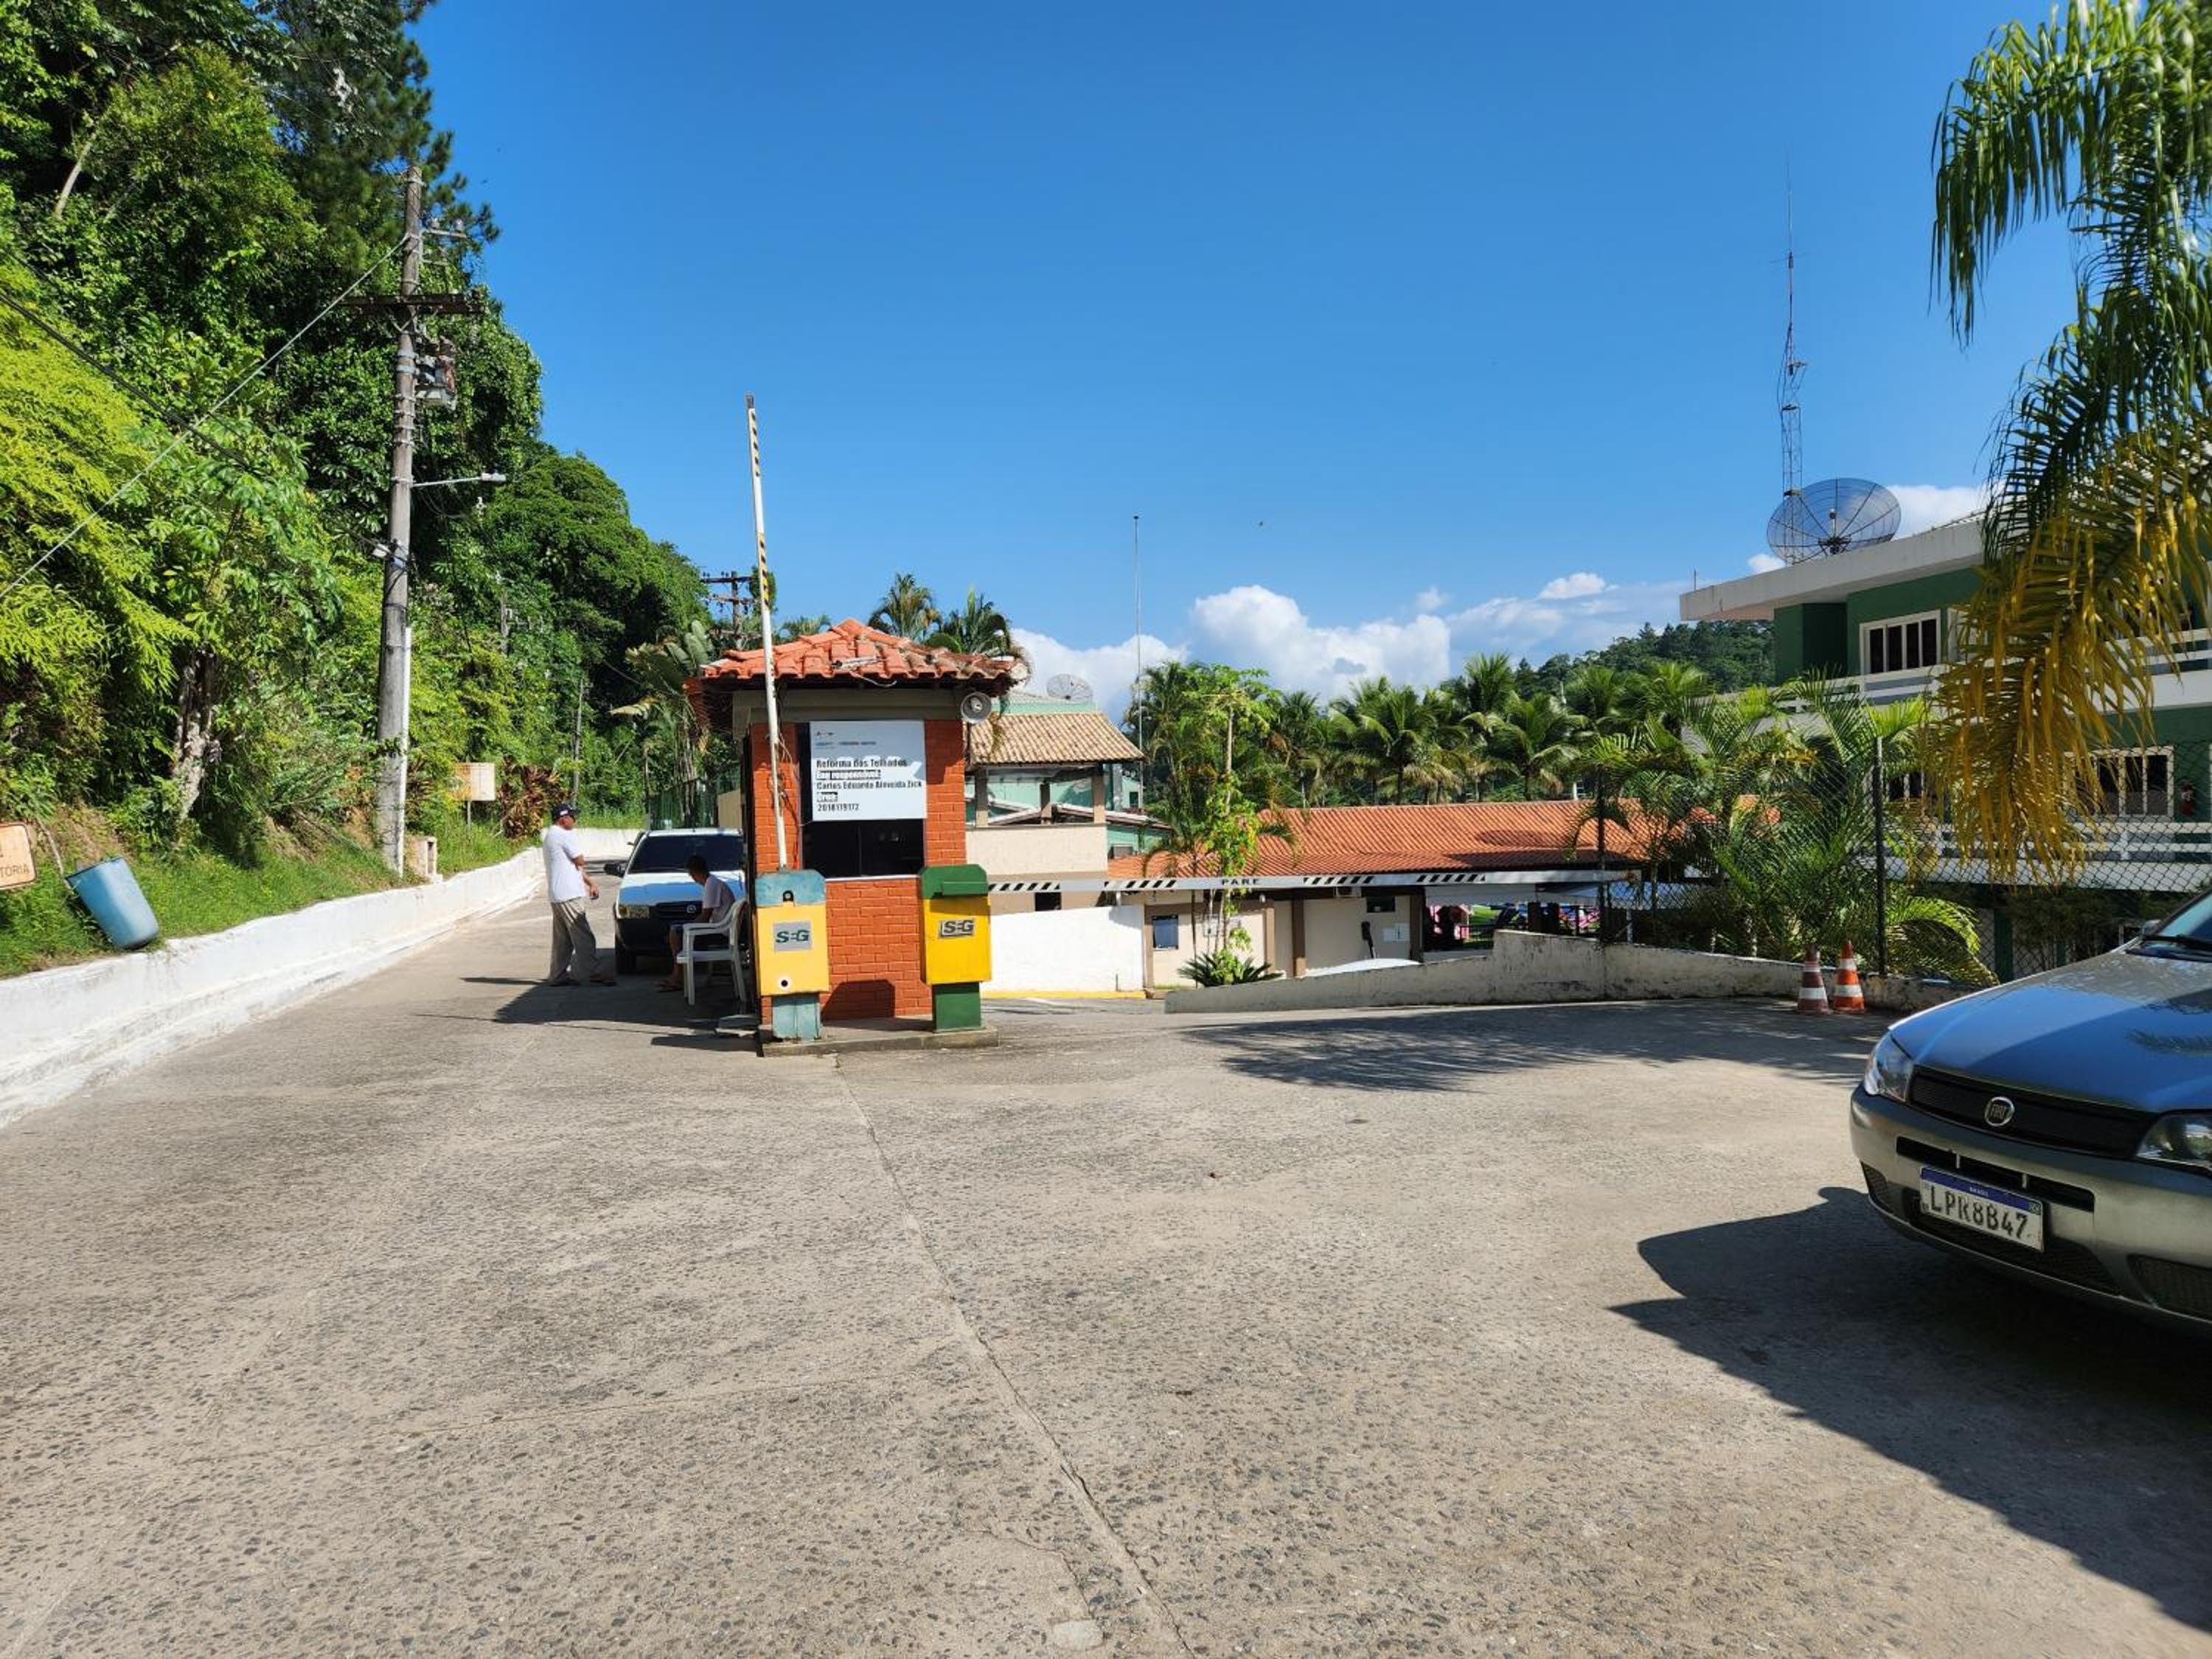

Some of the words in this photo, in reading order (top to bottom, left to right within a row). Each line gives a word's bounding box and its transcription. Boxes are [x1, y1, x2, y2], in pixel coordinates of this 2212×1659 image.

[816, 759, 852, 768] Reforma
[871, 758, 908, 767] Telhados
[817, 782, 841, 790] Carlos
[1930, 1185, 2029, 1239] LPR8B47
